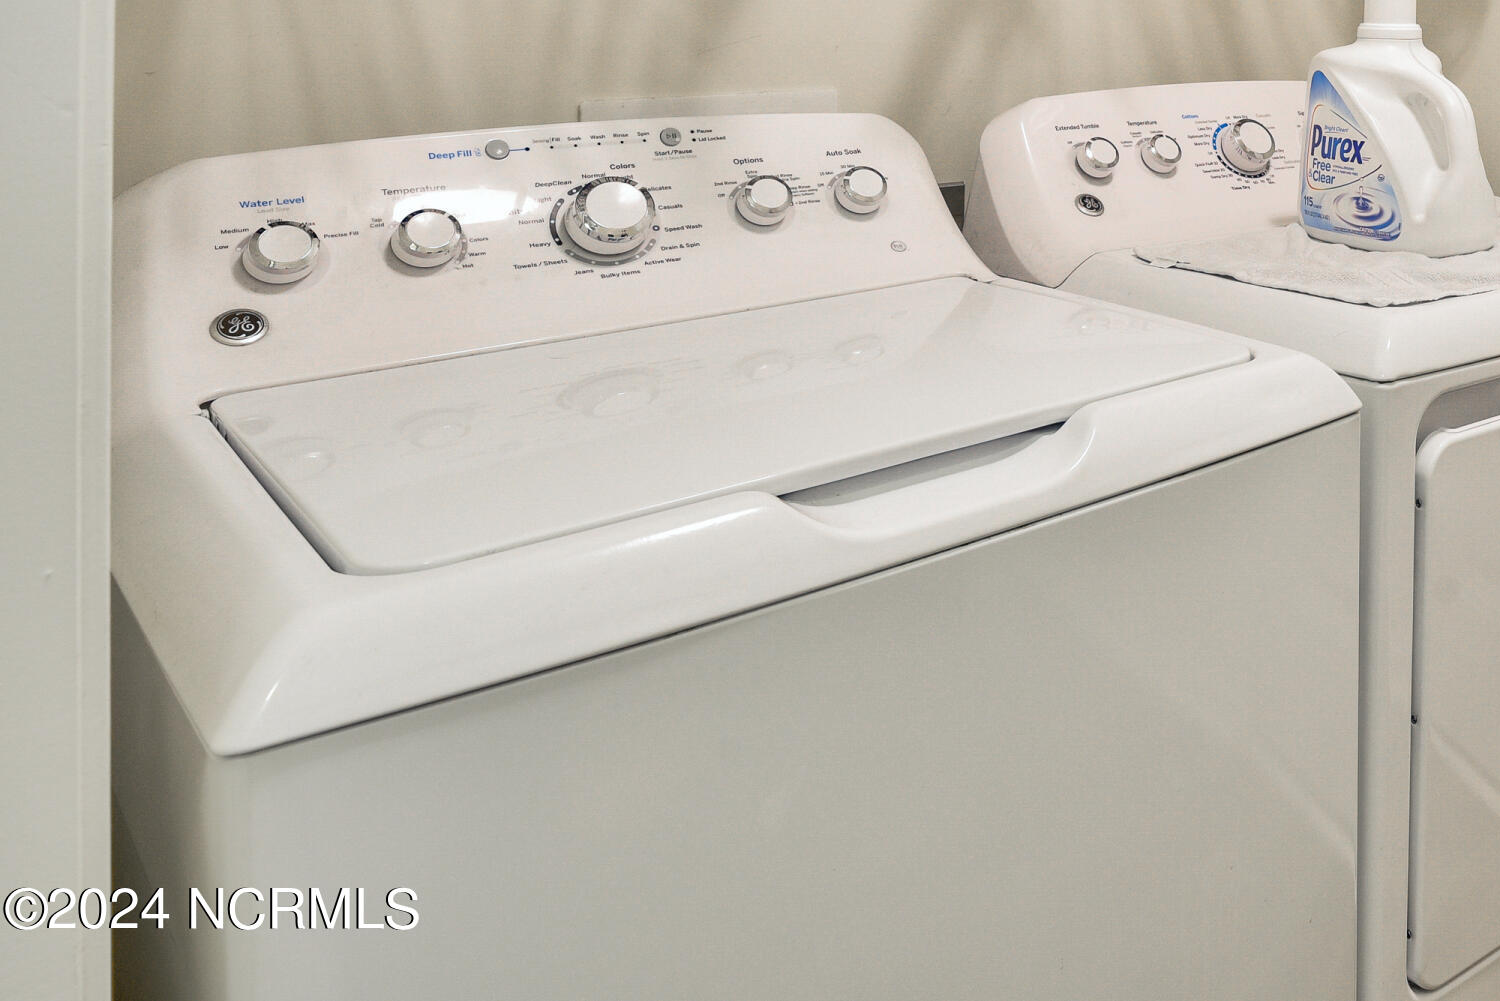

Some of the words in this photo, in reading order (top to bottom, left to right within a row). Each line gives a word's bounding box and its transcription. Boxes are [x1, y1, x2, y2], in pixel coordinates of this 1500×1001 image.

[1055, 124, 1080, 132] Extended
[1126, 120, 1158, 128] Temperature
[1311, 124, 1365, 165] Purex
[428, 152, 455, 160] Deep
[457, 149, 473, 158] Fill
[654, 148, 693, 157] Start/Pause
[825, 149, 843, 157] Auto
[843, 148, 862, 156] Soak
[732, 156, 764, 166] Options
[1312, 158, 1331, 172] Free
[609, 162, 636, 170] Colors
[1312, 170, 1336, 185] Clear
[534, 180, 572, 188] DeepClean
[381, 185, 447, 196] Temperature
[239, 199, 273, 209] Water
[276, 196, 305, 206] Level
[1304, 195, 1314, 207] 115
[658, 203, 684, 211] Casuals
[518, 218, 545, 226] Normal
[220, 227, 250, 236] Medium
[323, 231, 348, 239] Precise
[529, 241, 551, 249] Heavy
[685, 241, 700, 249] Spin
[468, 250, 487, 258] Warm
[513, 262, 538, 270] Towels
[543, 258, 568, 267] Sheets
[644, 258, 665, 266] Active
[664, 256, 682, 264] Wear
[574, 268, 594, 276] Jeans
[620, 269, 641, 277] Items
